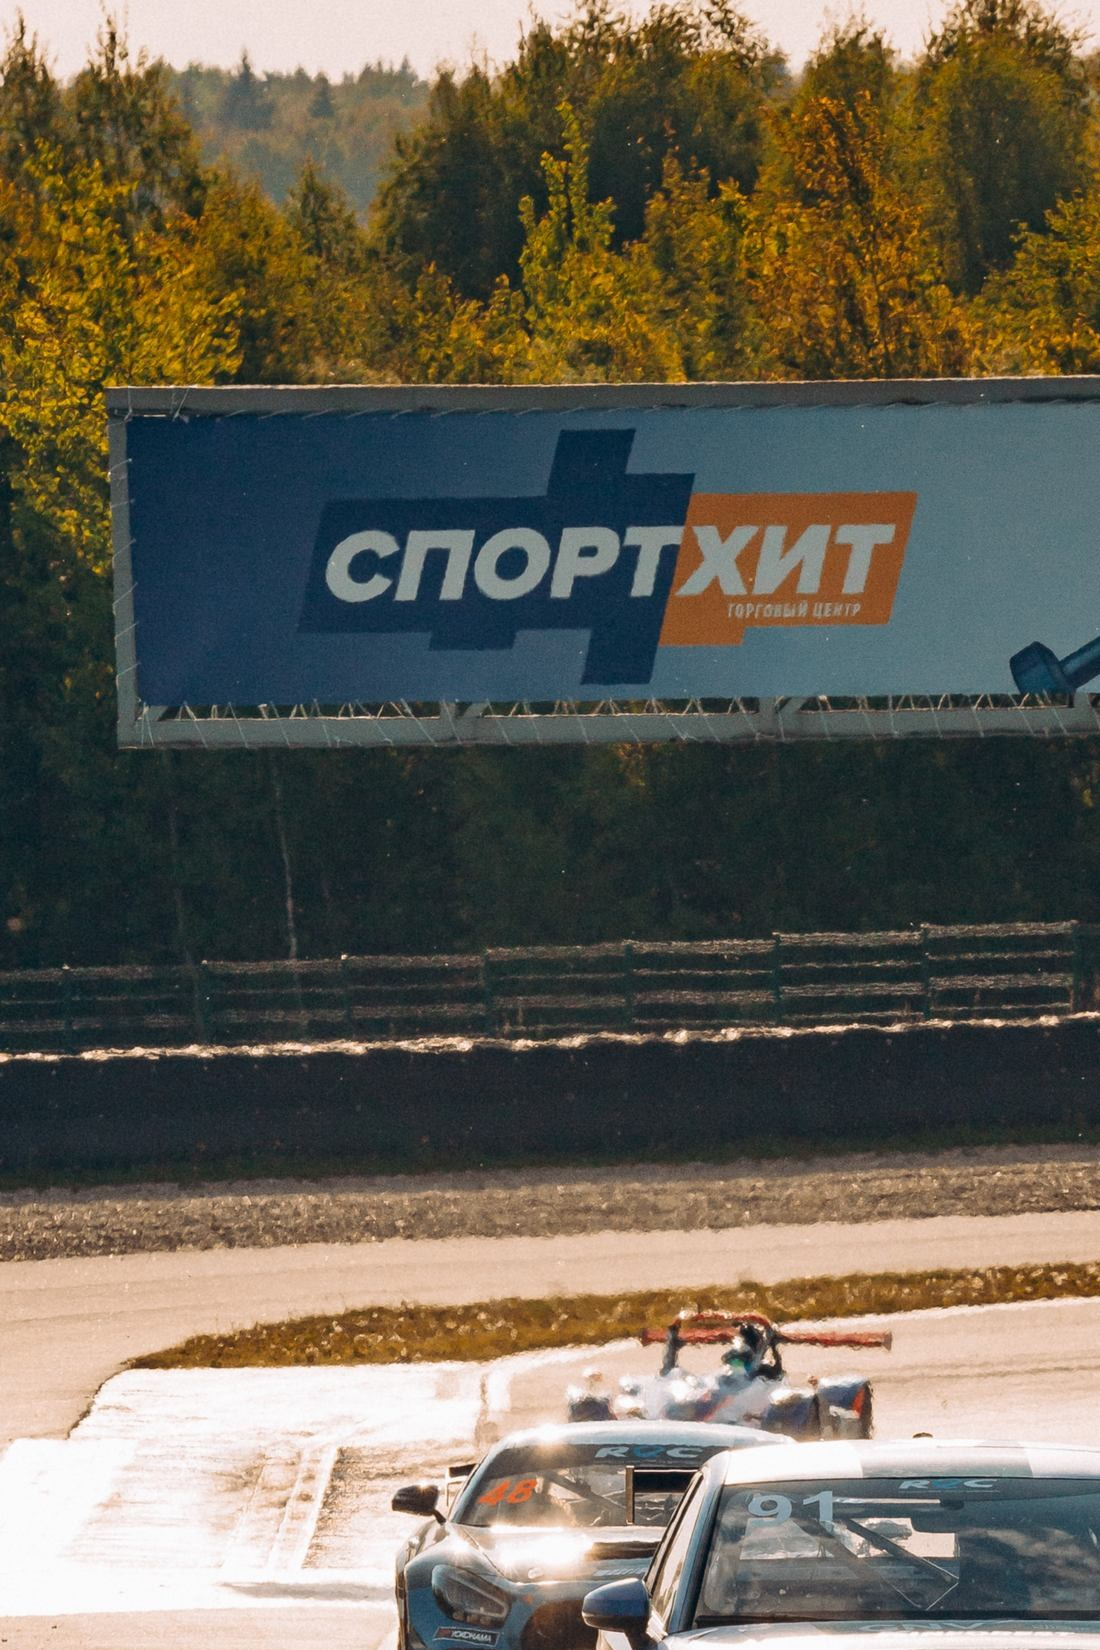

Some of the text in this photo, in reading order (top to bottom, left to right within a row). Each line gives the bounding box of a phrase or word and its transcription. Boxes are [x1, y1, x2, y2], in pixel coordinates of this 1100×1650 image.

[728, 602, 861, 618] ТОРГОВЫЙ ЦЕНТР
[477, 1478, 538, 1507] 48
[747, 1490, 833, 1527] 91
[450, 1629, 492, 1643] YOKOHAMA
